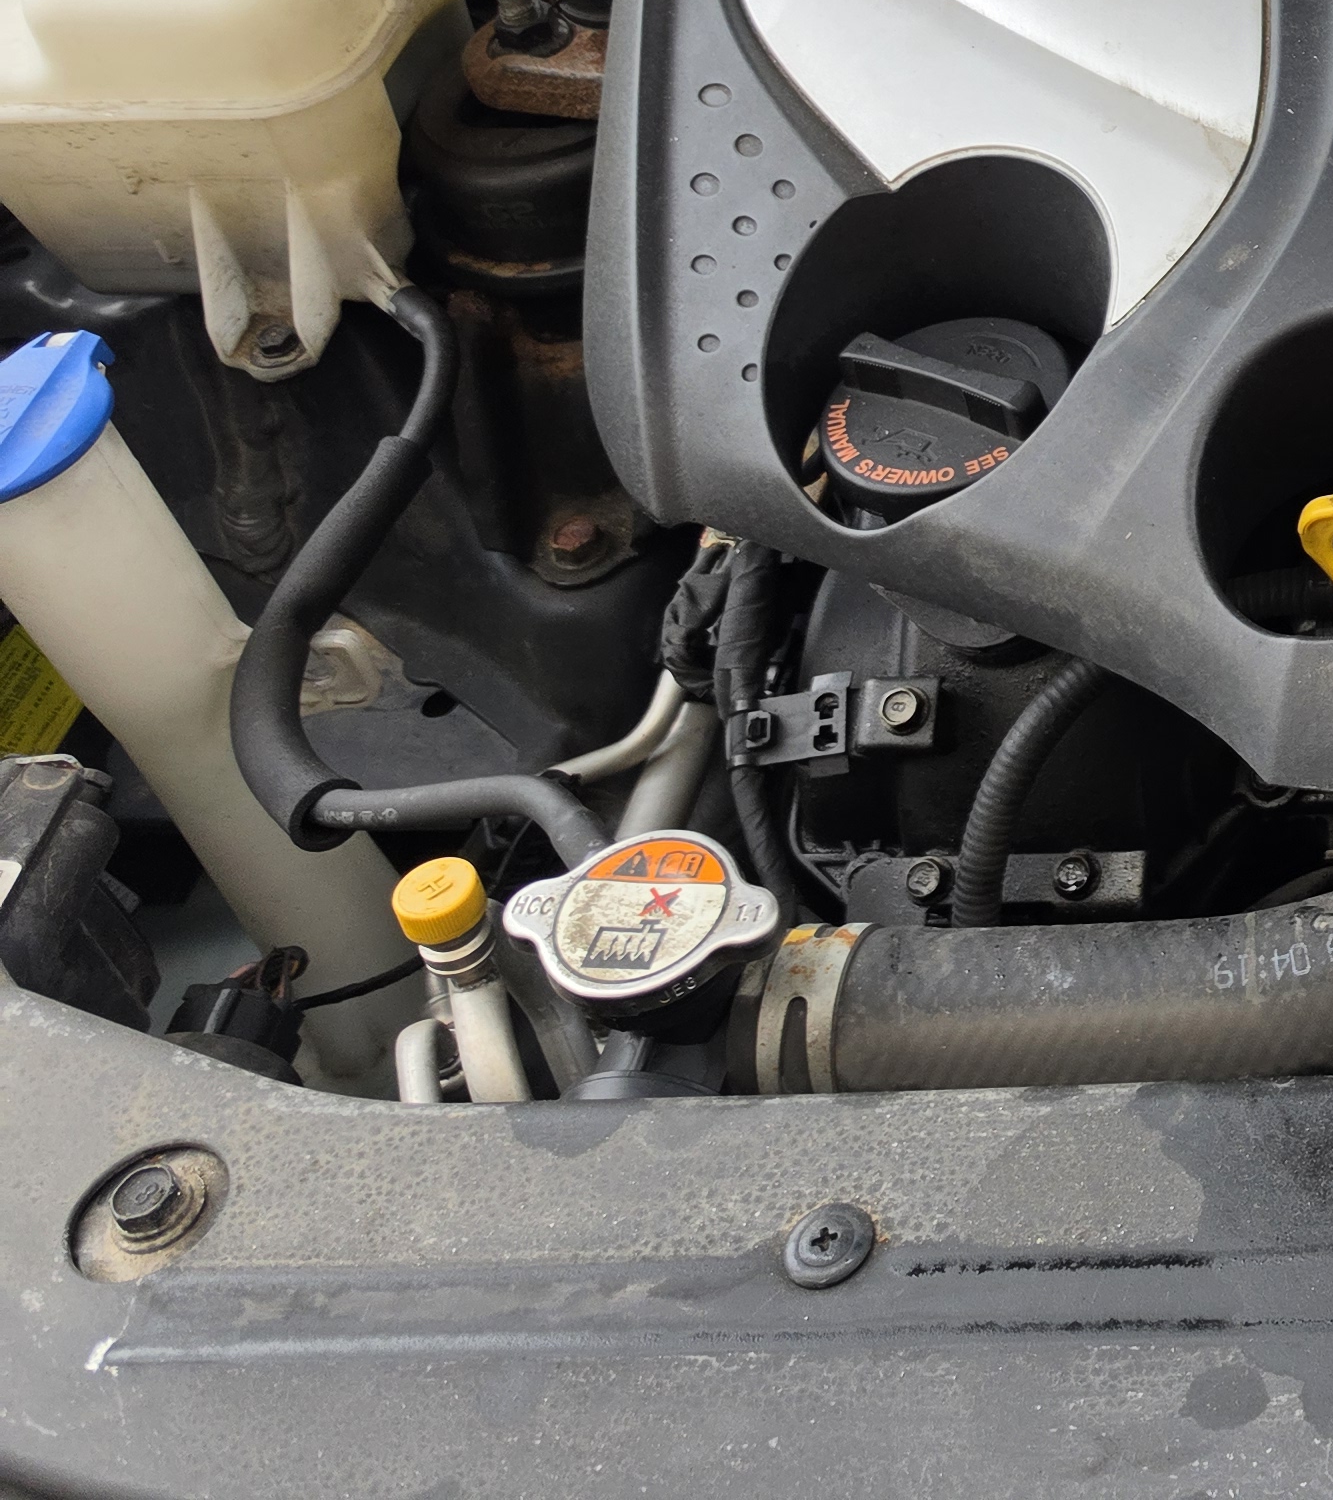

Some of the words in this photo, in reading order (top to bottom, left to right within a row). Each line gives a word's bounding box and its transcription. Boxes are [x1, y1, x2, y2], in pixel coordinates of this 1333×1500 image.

[826, 398, 860, 463] MANUAL
[854, 458, 955, 485] OWNER'S
[964, 446, 1010, 476] SEE
[417, 874, 454, 901] H
[512, 894, 556, 916] HCC
[1213, 942, 1313, 990] 04:19
